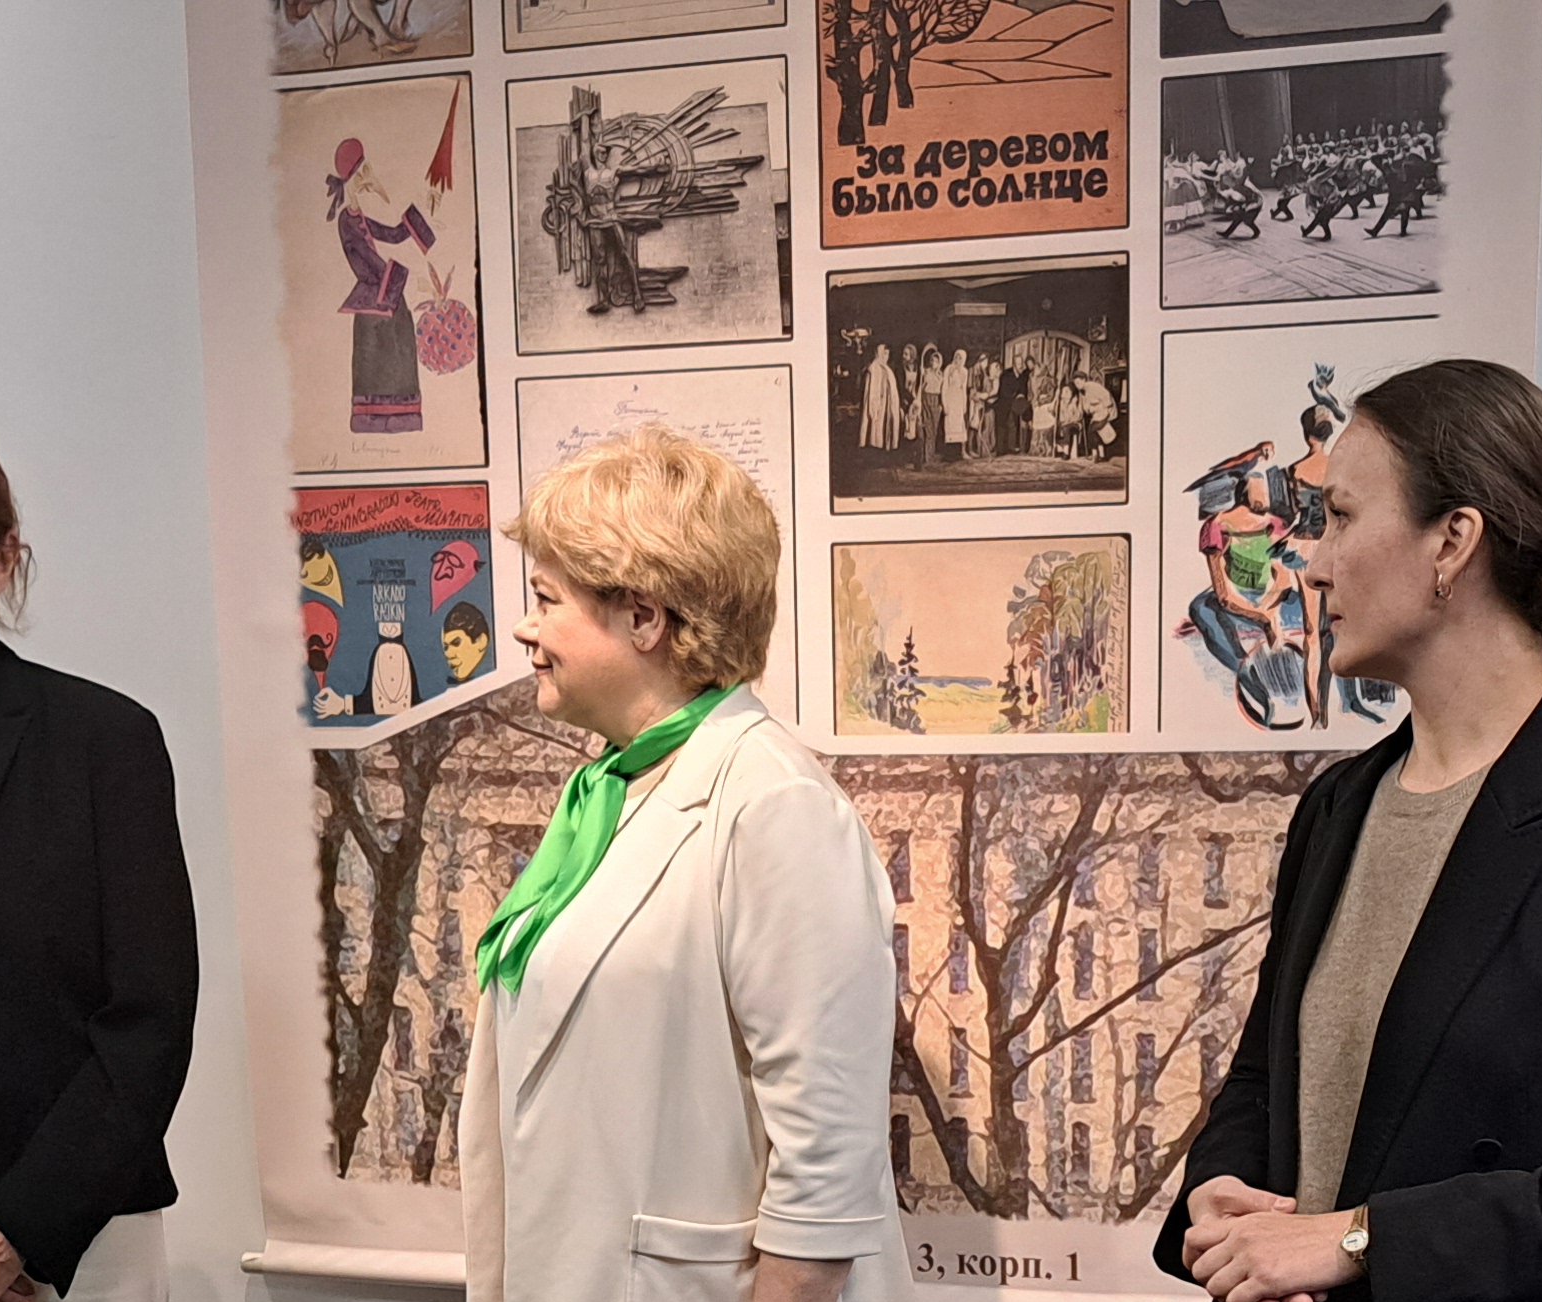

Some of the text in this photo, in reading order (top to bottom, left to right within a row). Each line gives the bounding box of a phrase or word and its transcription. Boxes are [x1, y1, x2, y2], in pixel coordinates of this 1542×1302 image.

[856, 130, 1109, 178] за деревом
[832, 167, 1108, 217] было солнце
[956, 1252, 1053, 1285] корп.
[1065, 1251, 1082, 1282] 1
